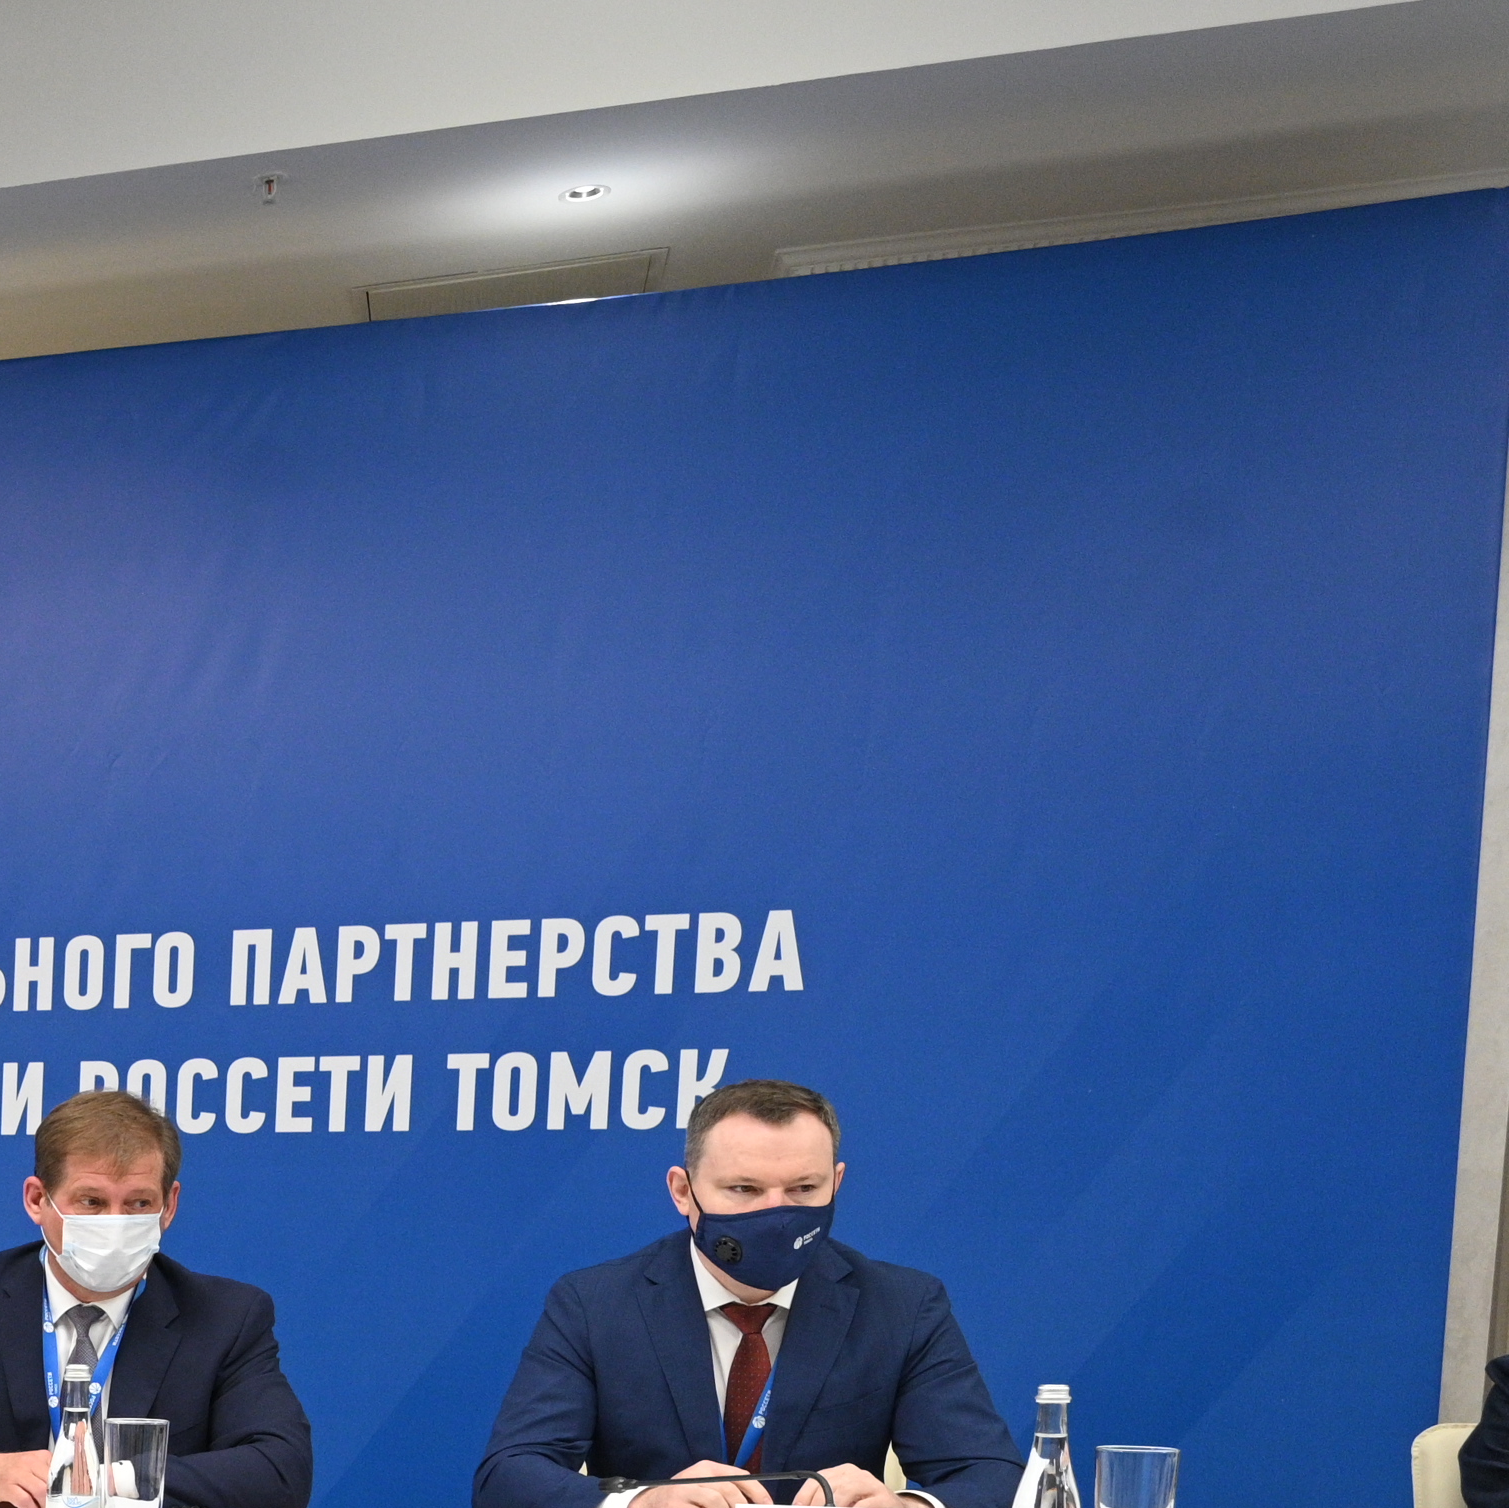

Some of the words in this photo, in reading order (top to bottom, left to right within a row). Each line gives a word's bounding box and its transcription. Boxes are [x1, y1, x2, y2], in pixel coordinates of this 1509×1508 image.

[229, 909, 804, 1006] ПАРТНЕРСТВА
[0, 1061, 44, 1136] И
[79, 1054, 413, 1135] РОССЕТИ
[446, 1048, 730, 1131] ТОМСК
